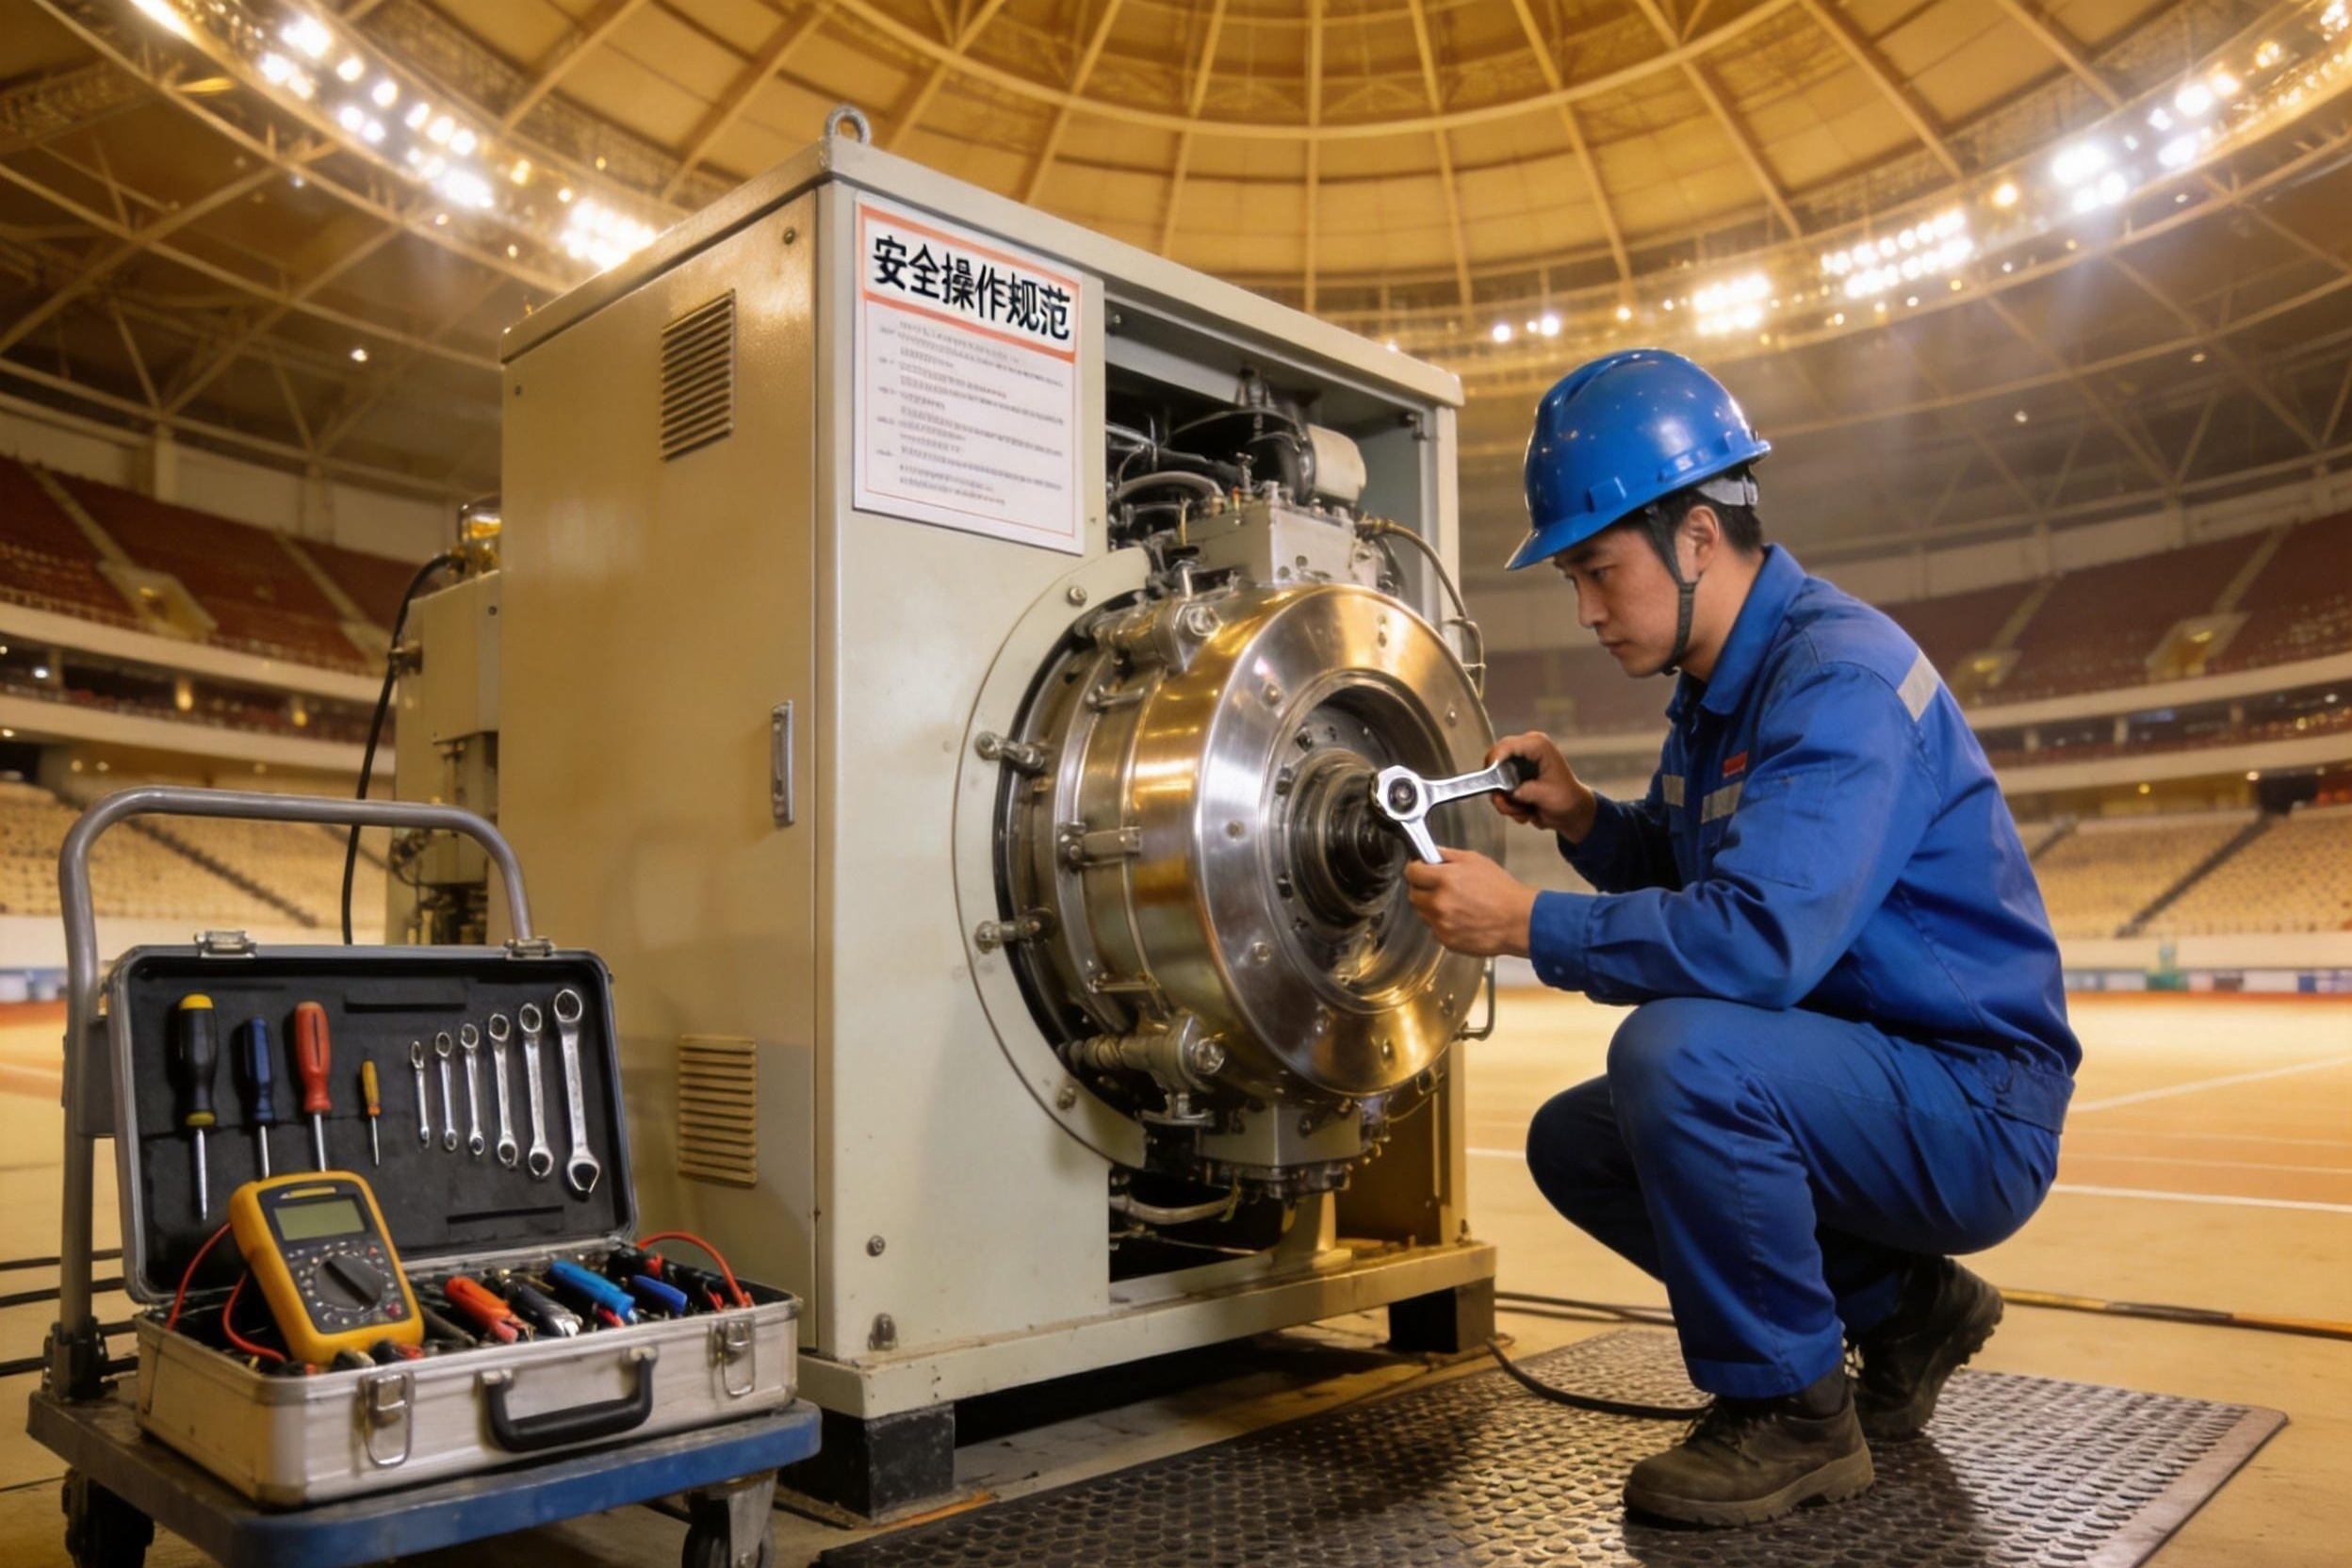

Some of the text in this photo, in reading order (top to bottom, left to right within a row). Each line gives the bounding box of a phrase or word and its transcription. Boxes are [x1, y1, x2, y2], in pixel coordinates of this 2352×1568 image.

[873, 236, 1070, 340] 安全操作规范
